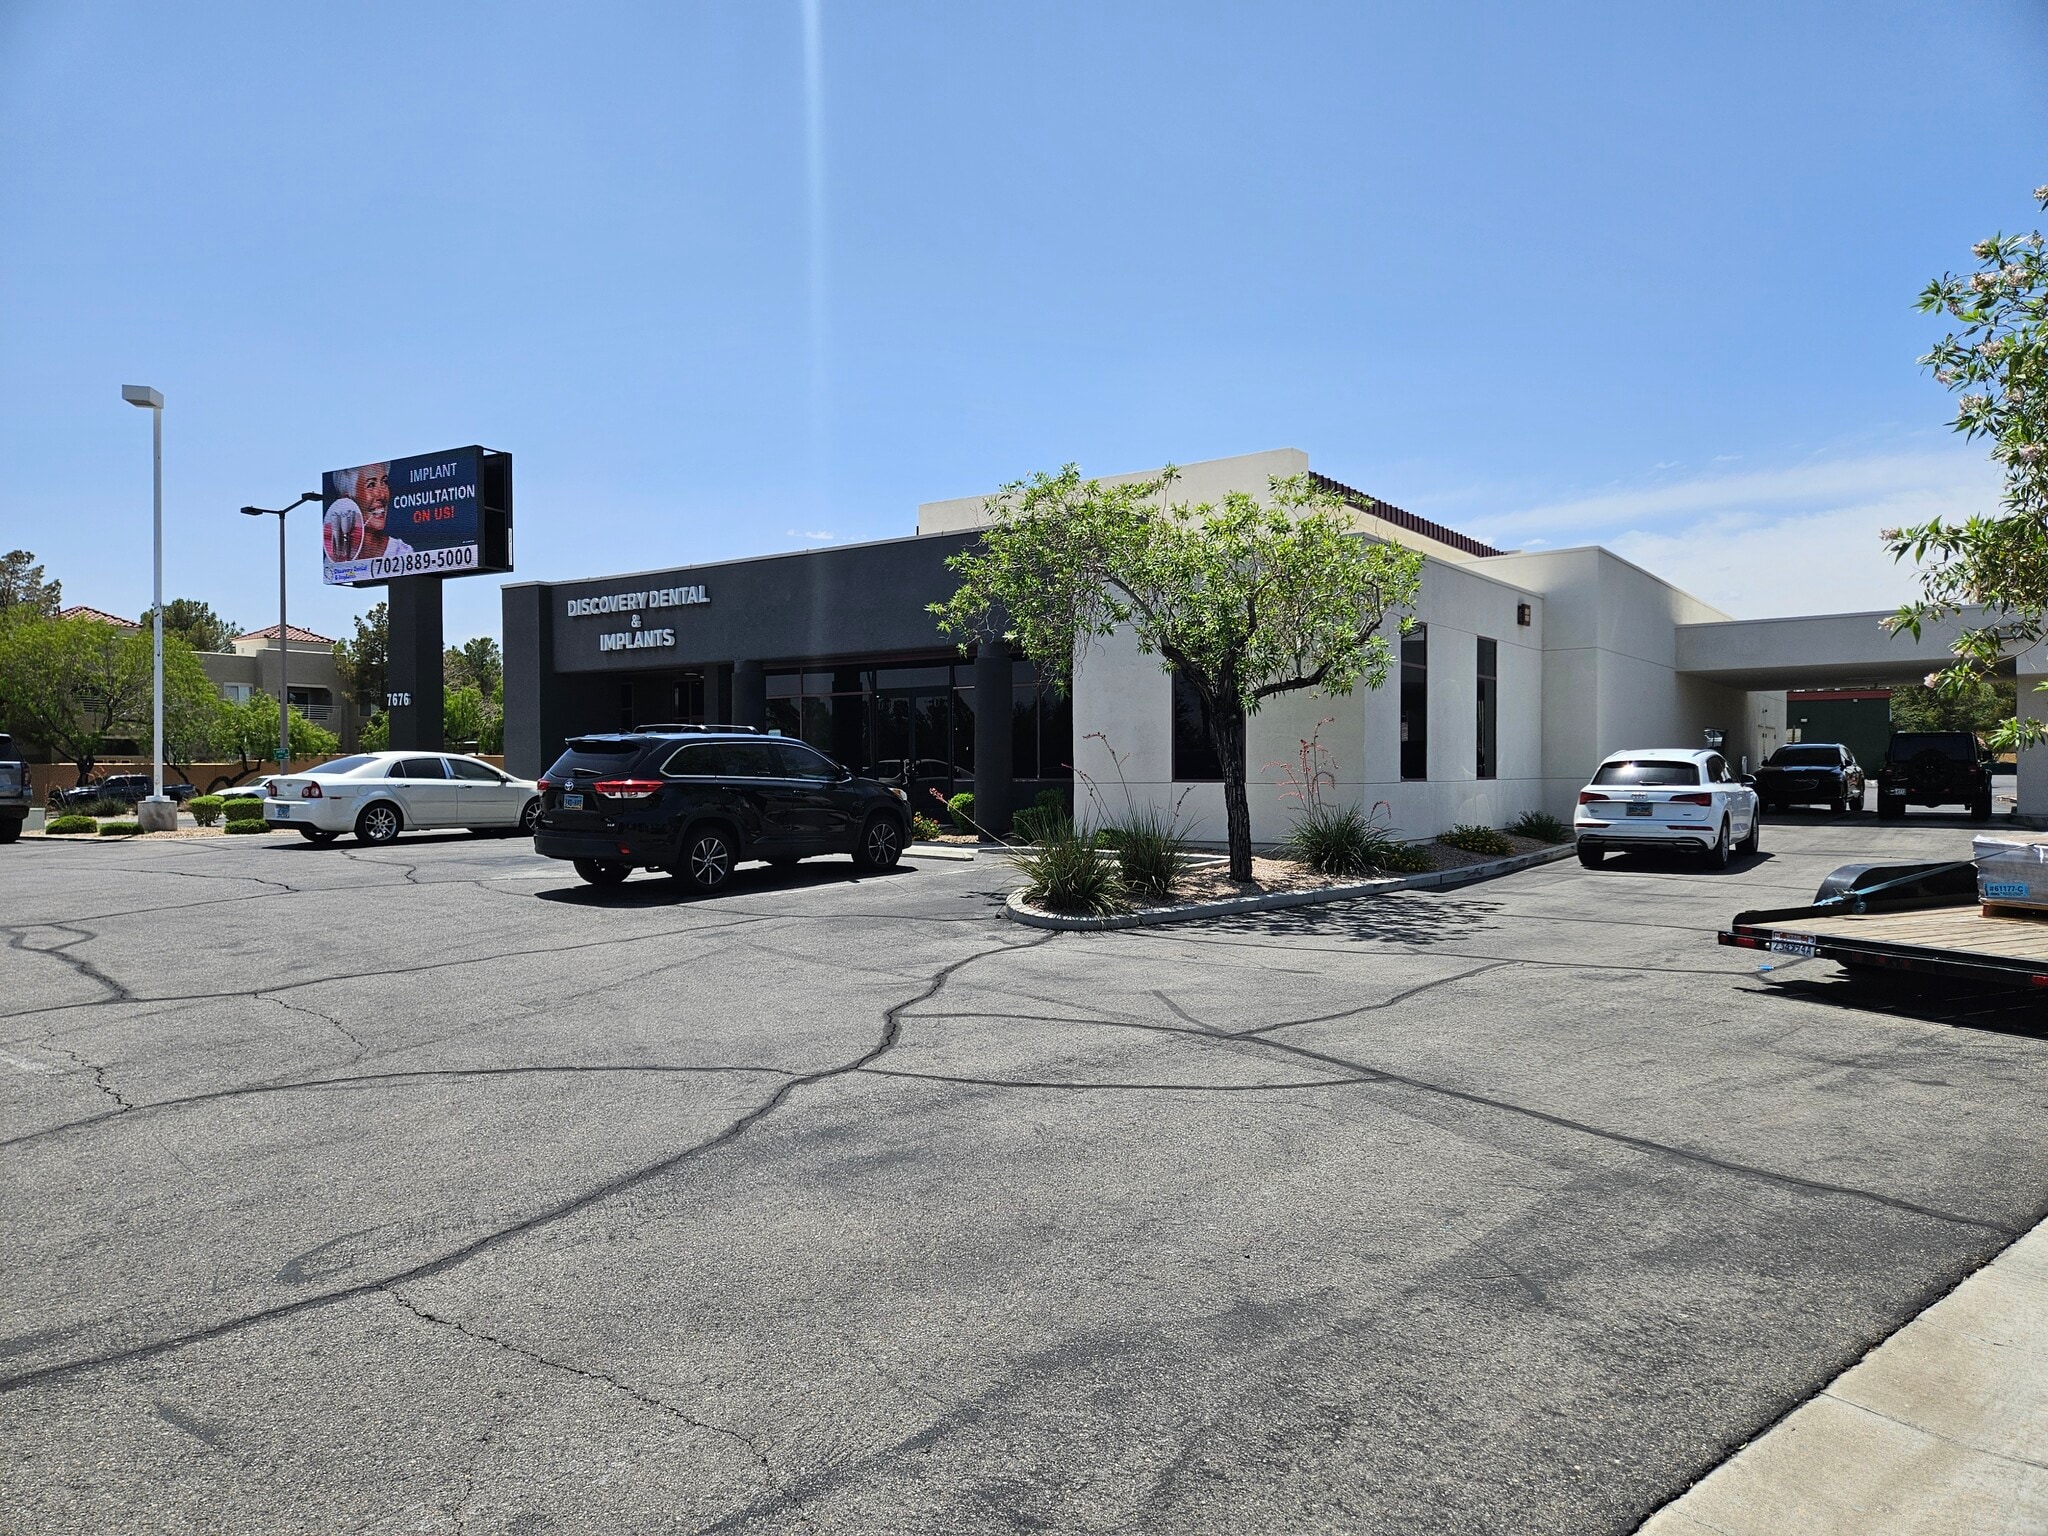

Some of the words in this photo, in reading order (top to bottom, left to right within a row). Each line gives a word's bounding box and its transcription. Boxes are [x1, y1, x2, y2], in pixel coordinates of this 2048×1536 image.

[410, 462, 457, 483] IMPLANT
[393, 484, 475, 509] CONSULTATION
[413, 508, 431, 523] ON
[434, 505, 455, 520] US!
[370, 548, 472, 578] (702)889-5000
[567, 591, 649, 617] DISCOVERY
[649, 585, 711, 608] DENTAL
[630, 614, 642, 628] &
[600, 628, 676, 651] IMPLANTS
[386, 692, 411, 706] 7676
